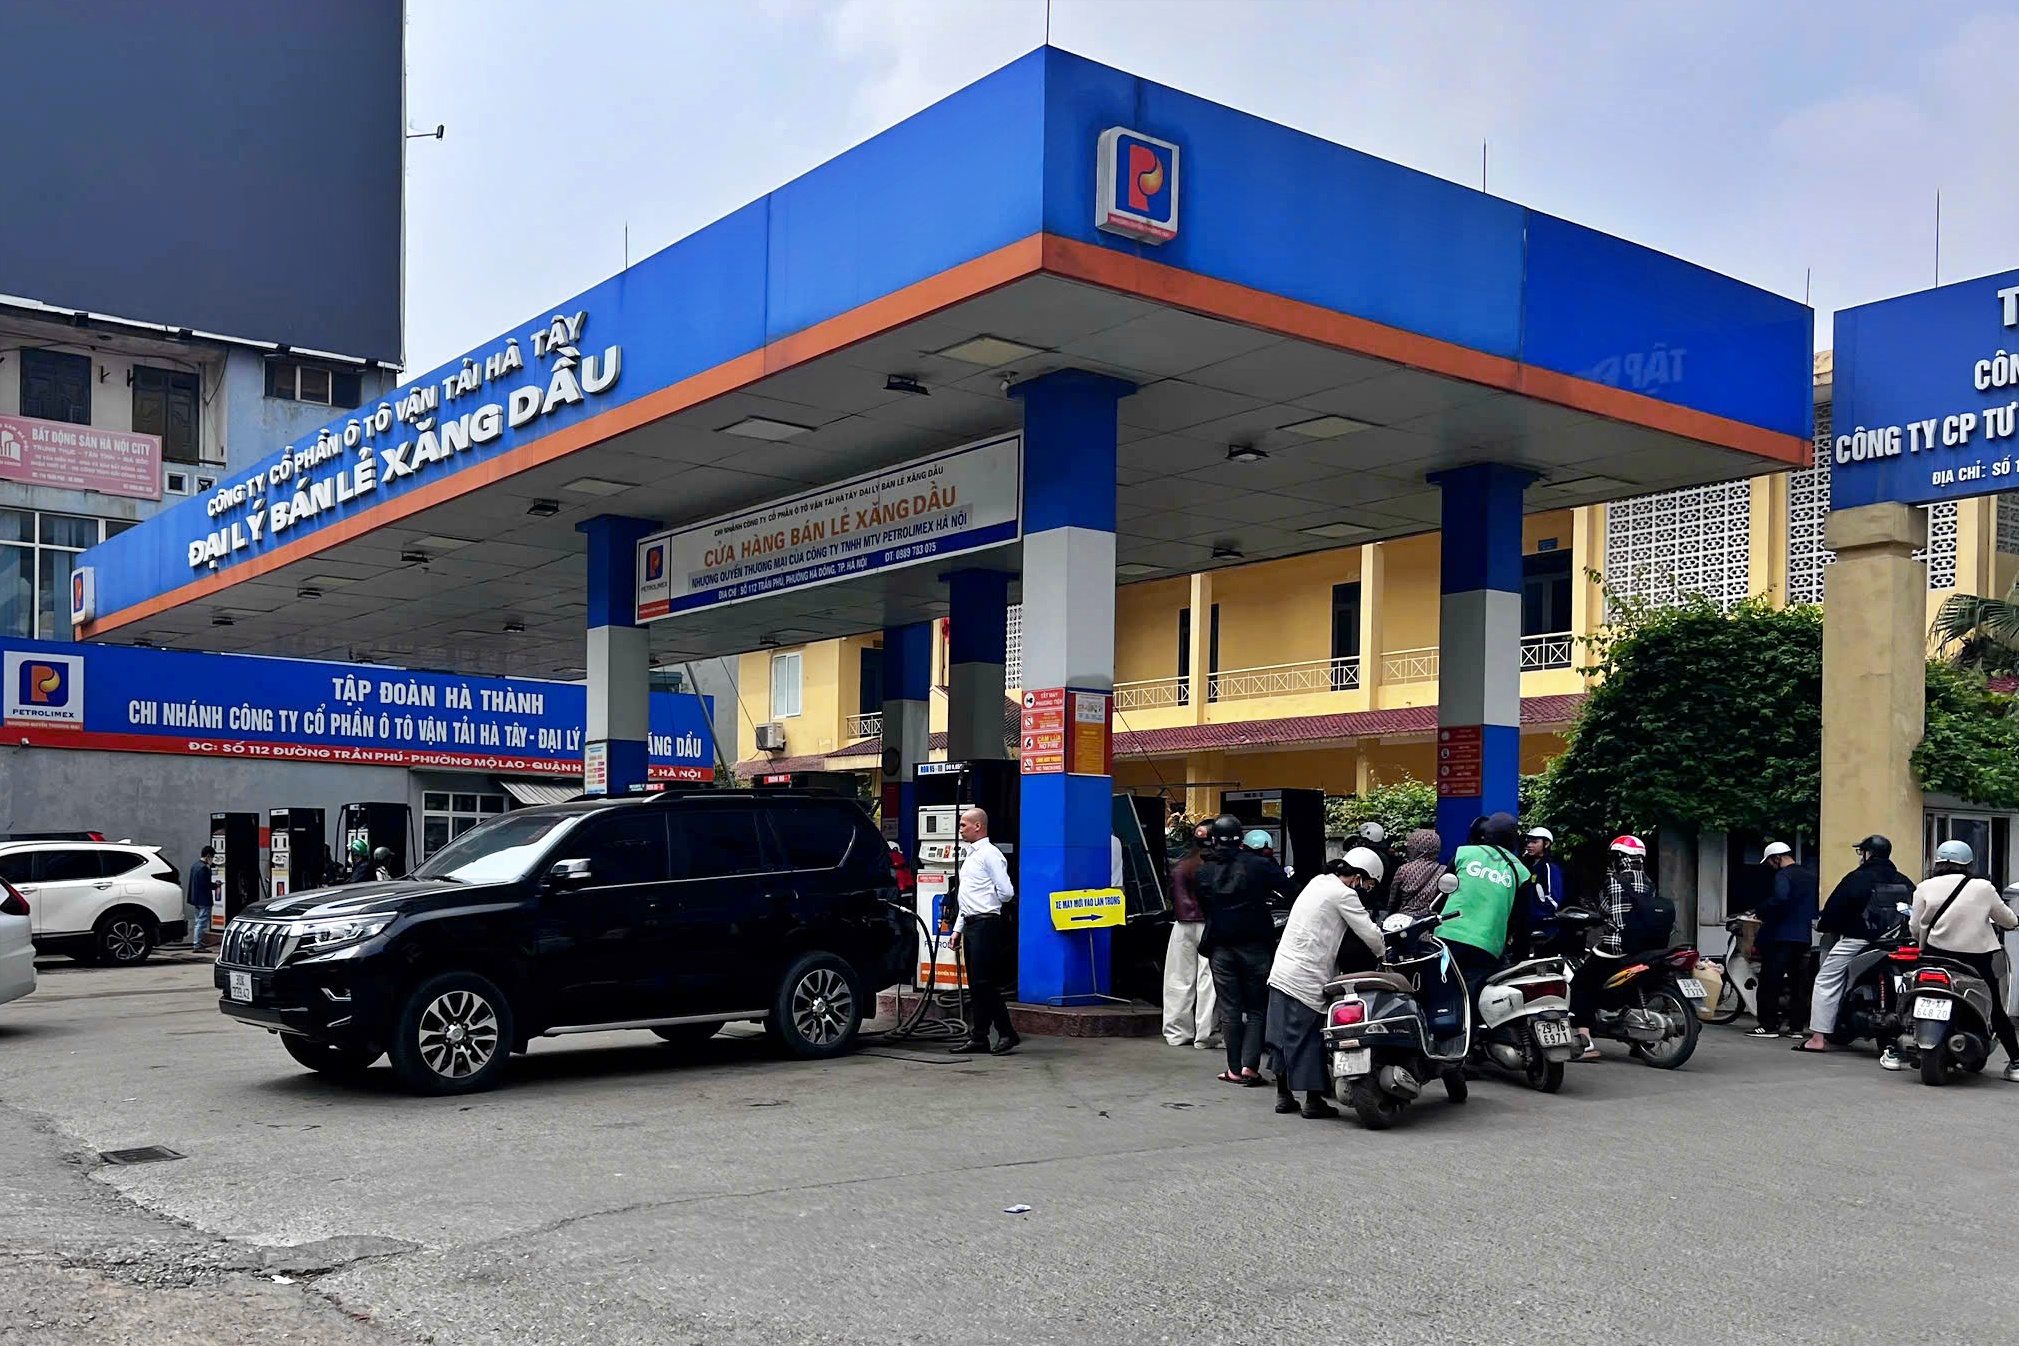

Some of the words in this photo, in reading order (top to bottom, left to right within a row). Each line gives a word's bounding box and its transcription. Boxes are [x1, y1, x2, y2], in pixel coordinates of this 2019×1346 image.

[207, 484, 246, 517] CÔNG
[246, 473, 266, 497] TY
[269, 446, 294, 485] CỔ
[294, 429, 342, 473] PHẦN
[343, 419, 361, 447] Ô
[363, 402, 392, 438] TÔ
[395, 386, 440, 424] VẬN
[442, 357, 482, 400] TẢI
[485, 338, 523, 381] HÀ
[530, 310, 587, 358] TÂY
[32, 426, 49, 442] BẤT
[100, 435, 111, 451] HÀ
[114, 438, 130, 455] NỘI
[132, 442, 151, 456] CITY
[188, 527, 233, 569] ĐẠI
[231, 498, 268, 550] LÝ
[271, 477, 336, 533] BÁN
[337, 446, 377, 503] LẺ
[380, 403, 504, 483] XĂNG
[509, 345, 622, 428] DẦU
[1836, 425, 1902, 464] CÔNG
[1907, 418, 1937, 452] TY
[1942, 412, 1977, 446] CP
[1932, 470, 1954, 488] ĐỊA
[1992, 454, 2011, 476] SỐ
[704, 541, 735, 568] CỬA
[741, 531, 785, 559] HÀNG
[791, 519, 825, 547] BÁN
[831, 506, 850, 537] LẺ
[855, 499, 909, 530] XĂNG
[913, 480, 956, 515] DẦU
[760, 516, 767, 524] TY
[773, 556, 788, 572] MẠI
[806, 545, 827, 562] CÔNG
[829, 543, 839, 555] TY
[841, 537, 862, 553] TNHH
[863, 531, 881, 549] MTV
[882, 520, 934, 544] PETROLIMEX
[936, 515, 949, 531] HÀ
[951, 510, 968, 530] NỘI
[912, 545, 924, 555] 783
[12, 708, 75, 719] PETROLIMEX
[332, 673, 372, 706] TẬP
[379, 678, 436, 707] ĐOÀN
[445, 683, 473, 710] HÀ
[480, 686, 544, 715] THÀNH
[128, 699, 157, 726] CHI
[163, 699, 223, 729] NHÁNH
[229, 702, 274, 732] CÔNG
[278, 710, 299, 733] TY
[303, 703, 326, 735] CỔ
[330, 707, 374, 738] PHẦN
[378, 712, 390, 739] Ô
[394, 714, 414, 741] TÔ
[418, 716, 447, 746] VẬN
[452, 715, 475, 745] TẢI
[479, 720, 500, 746] HÀ
[504, 722, 528, 748] TÂY
[538, 728, 562, 754] ĐẠI
[566, 726, 581, 751] LÝ
[647, 732, 672, 757] ĂNG
[676, 731, 702, 758] DẦU
[188, 742, 218, 751] ĐC:
[222, 740, 246, 754] SỐ
[248, 745, 270, 755] 112
[273, 745, 330, 759] ĐƯỜNG
[333, 747, 373, 760] TRẦN
[659, 768, 677, 778] HÀ
[679, 769, 702, 781] NỘI
[1466, 861, 1512, 888] Grab
